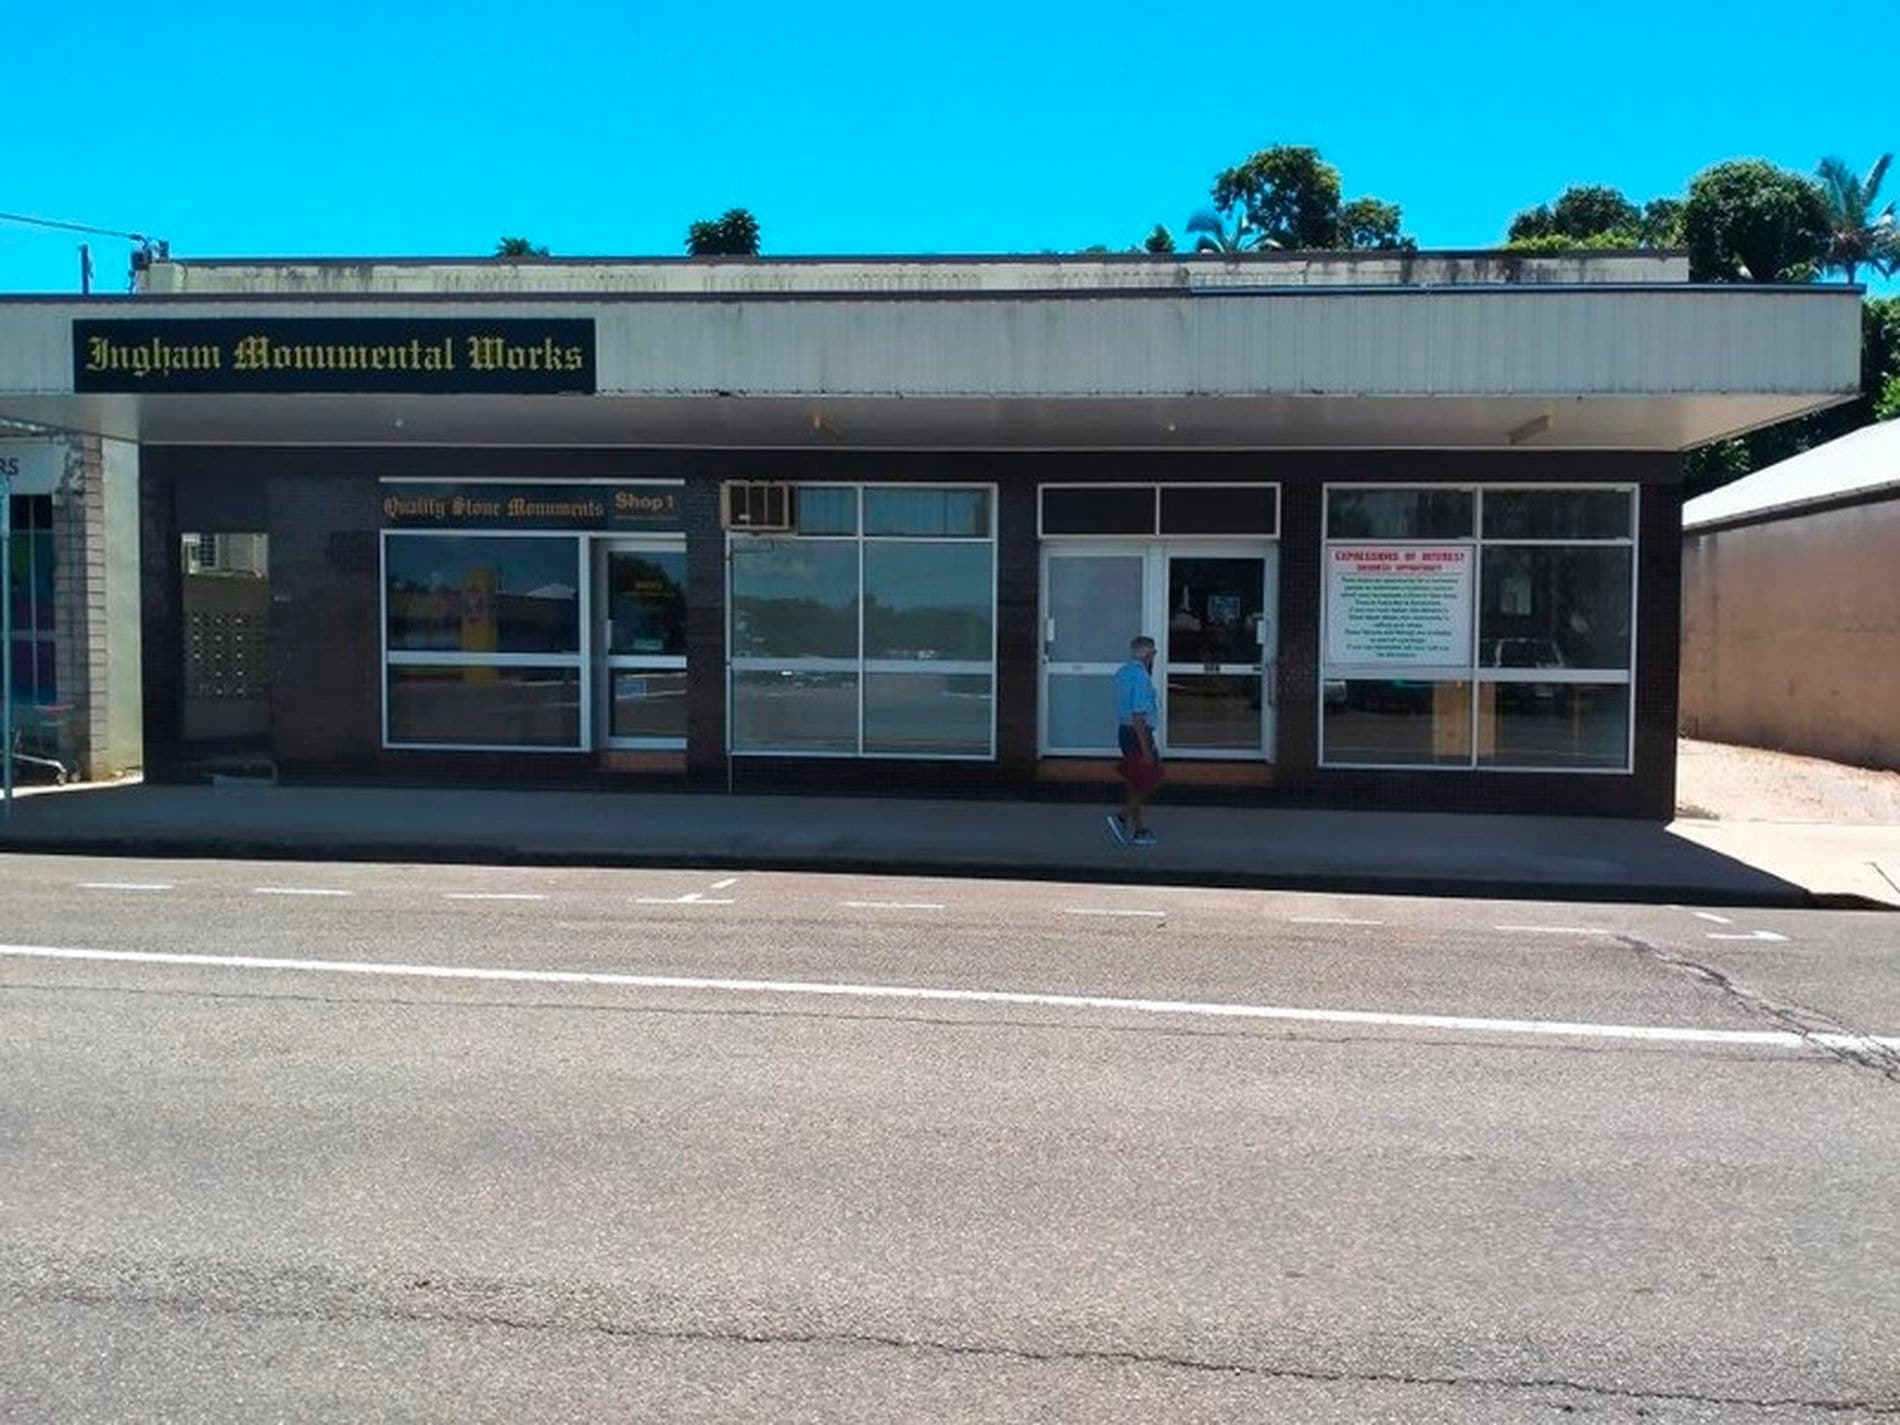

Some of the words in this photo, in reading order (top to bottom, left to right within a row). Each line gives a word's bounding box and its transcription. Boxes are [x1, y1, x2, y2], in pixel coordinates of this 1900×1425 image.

[86, 335, 221, 378] Ingham
[234, 335, 455, 371] Monumental
[468, 335, 583, 371] Works
[384, 495, 445, 519] Quality
[451, 496, 500, 516] Stone
[507, 497, 604, 517] Monuments
[614, 491, 663, 511] Shop
